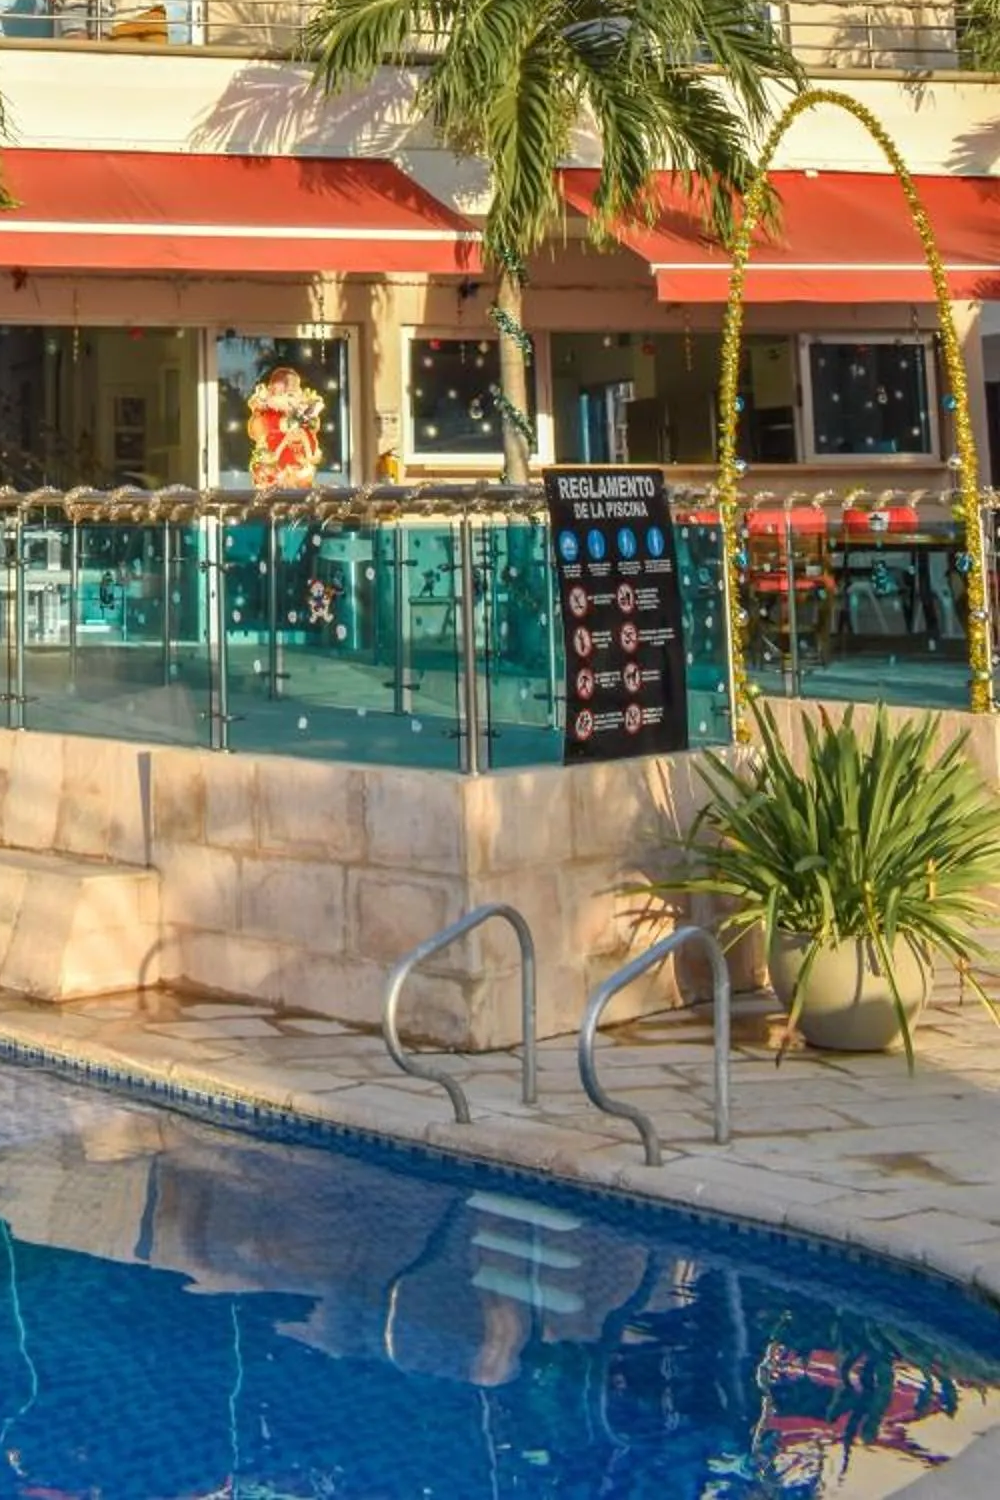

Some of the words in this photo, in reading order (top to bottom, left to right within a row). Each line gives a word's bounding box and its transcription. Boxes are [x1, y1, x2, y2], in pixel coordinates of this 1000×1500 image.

[558, 476, 655, 499] REGLAMENTO
[573, 503, 589, 519] DE
[590, 502, 605, 518] LA
[606, 501, 649, 518] PISCINA
